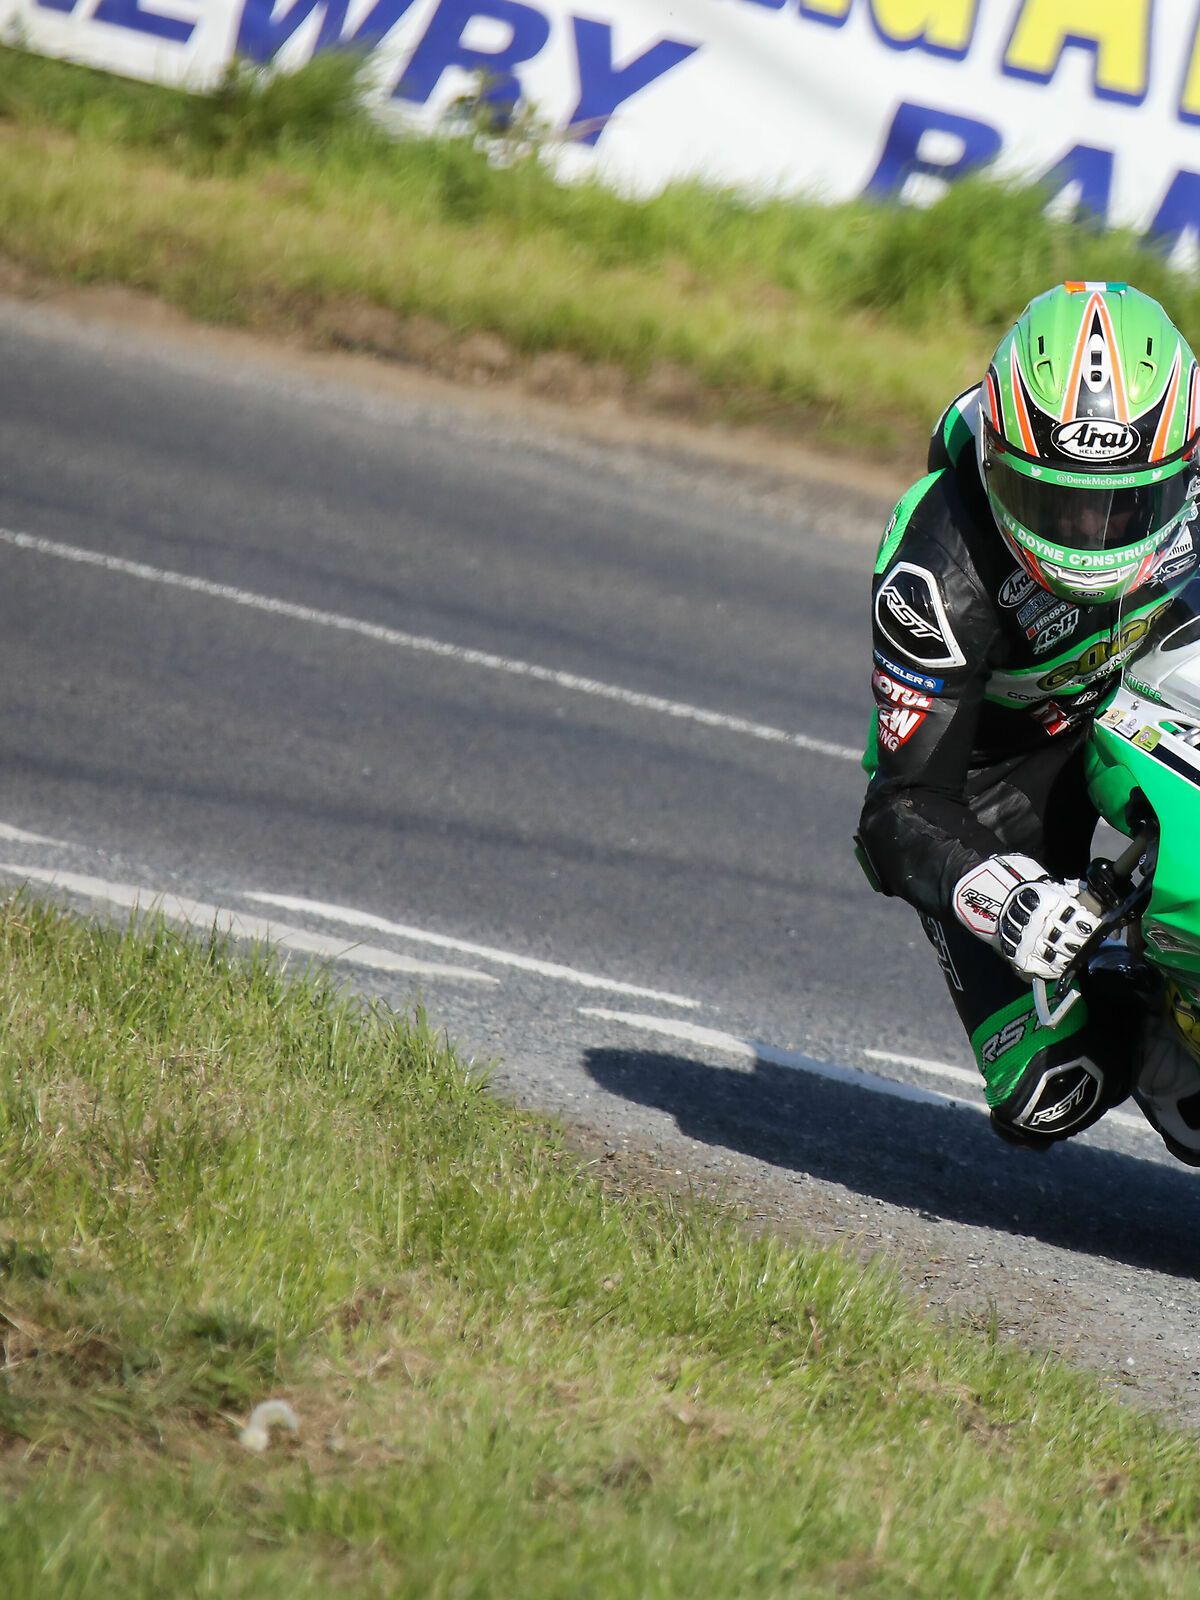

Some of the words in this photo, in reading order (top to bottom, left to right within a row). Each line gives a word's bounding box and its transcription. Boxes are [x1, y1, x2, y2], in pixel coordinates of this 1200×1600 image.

[1056, 423, 1130, 449] Arai
[1017, 529, 1065, 563] DOYNE
[1068, 518, 1180, 568] CONSTRUCTION
[880, 584, 944, 643] RST
[1127, 673, 1163, 703] McGee
[960, 887, 1004, 910] RST
[1030, 1072, 1092, 1127] RST
